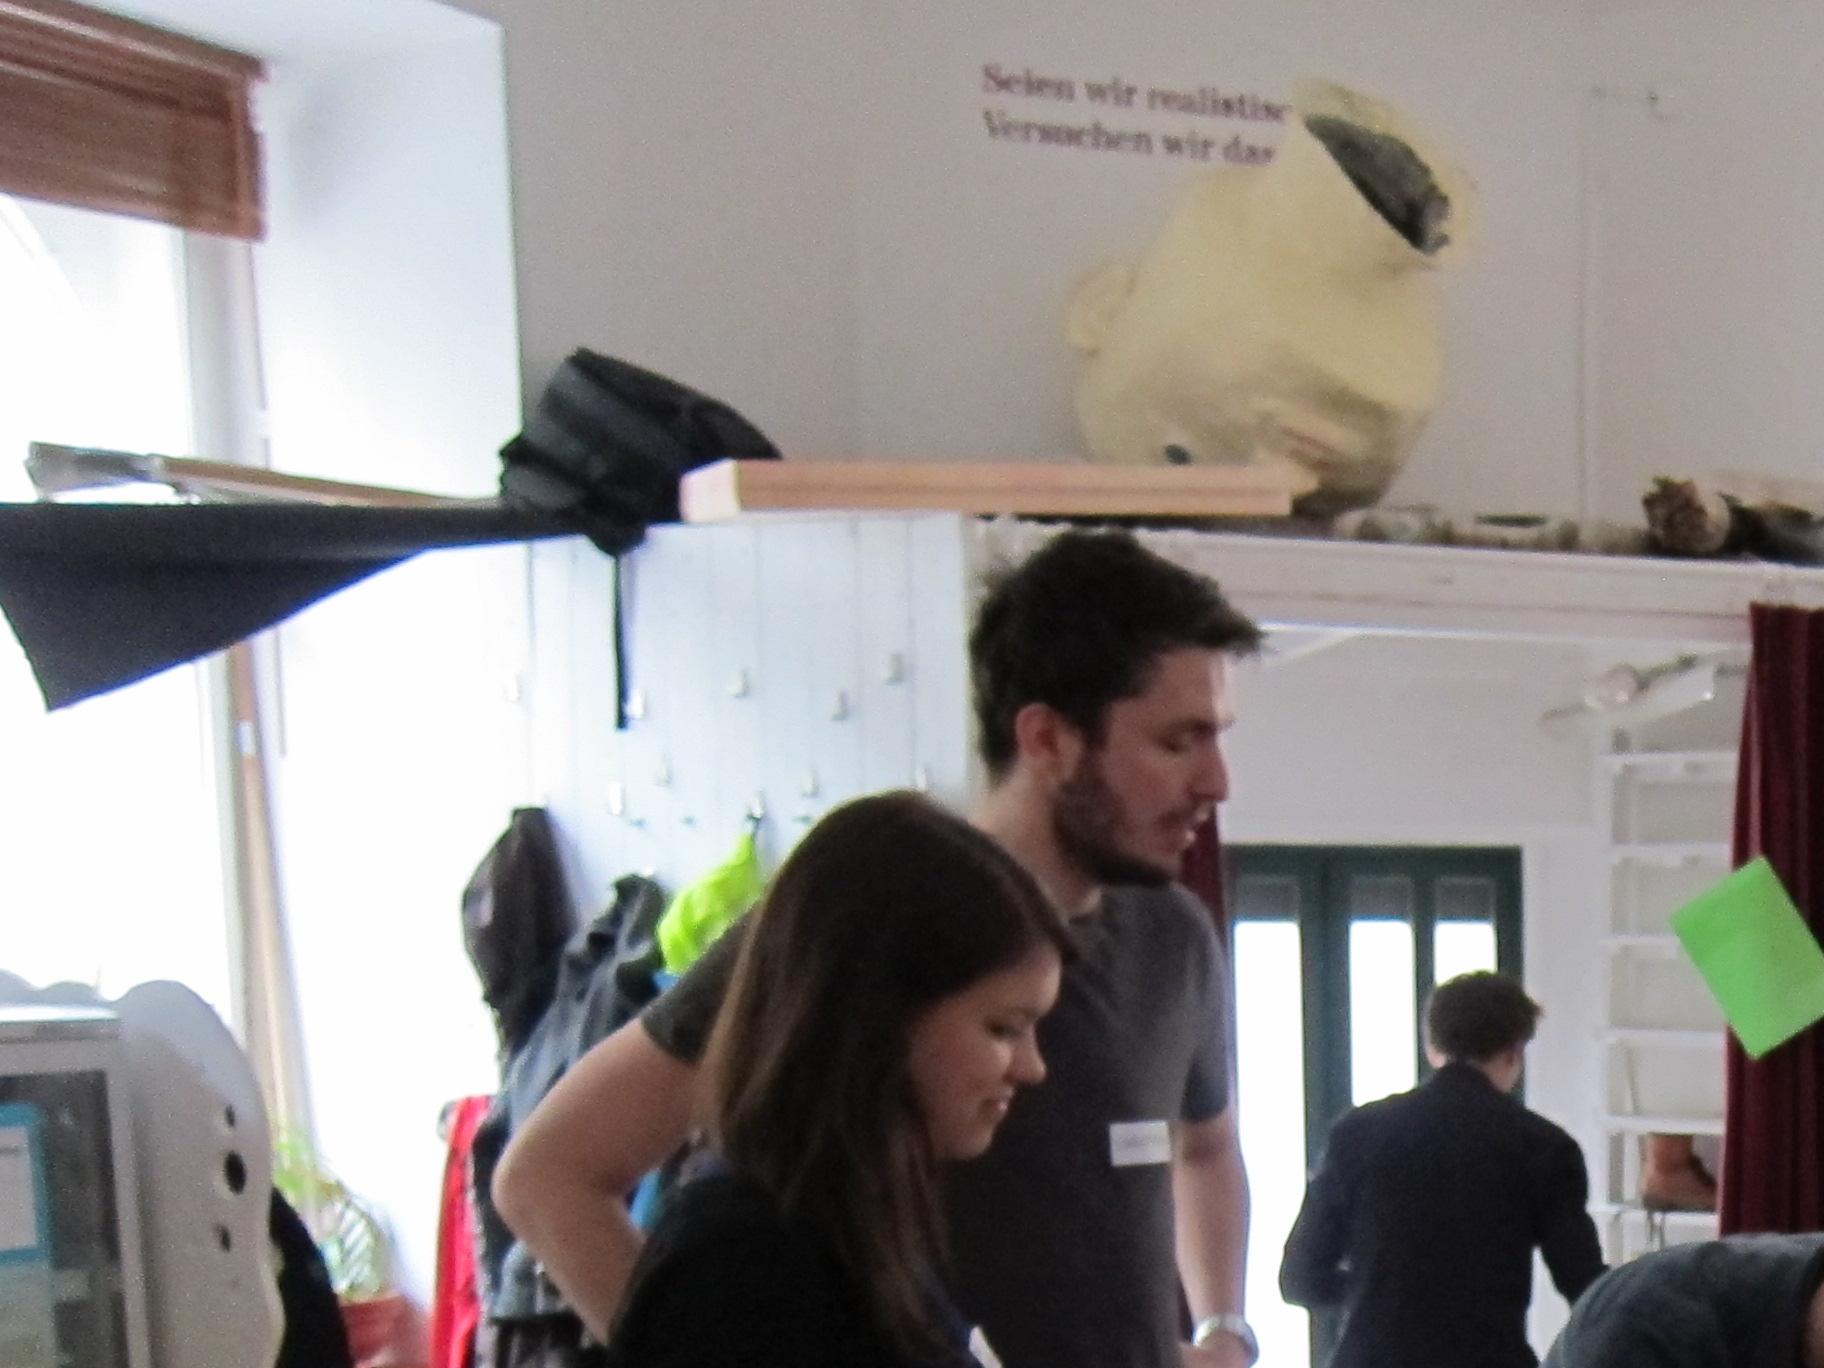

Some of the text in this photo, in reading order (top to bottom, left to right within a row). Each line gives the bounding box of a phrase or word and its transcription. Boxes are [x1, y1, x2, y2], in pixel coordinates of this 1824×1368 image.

[983, 62, 1076, 101] Seien
[1085, 76, 1138, 107] wir
[982, 108, 1276, 166] Versuchen wir das
